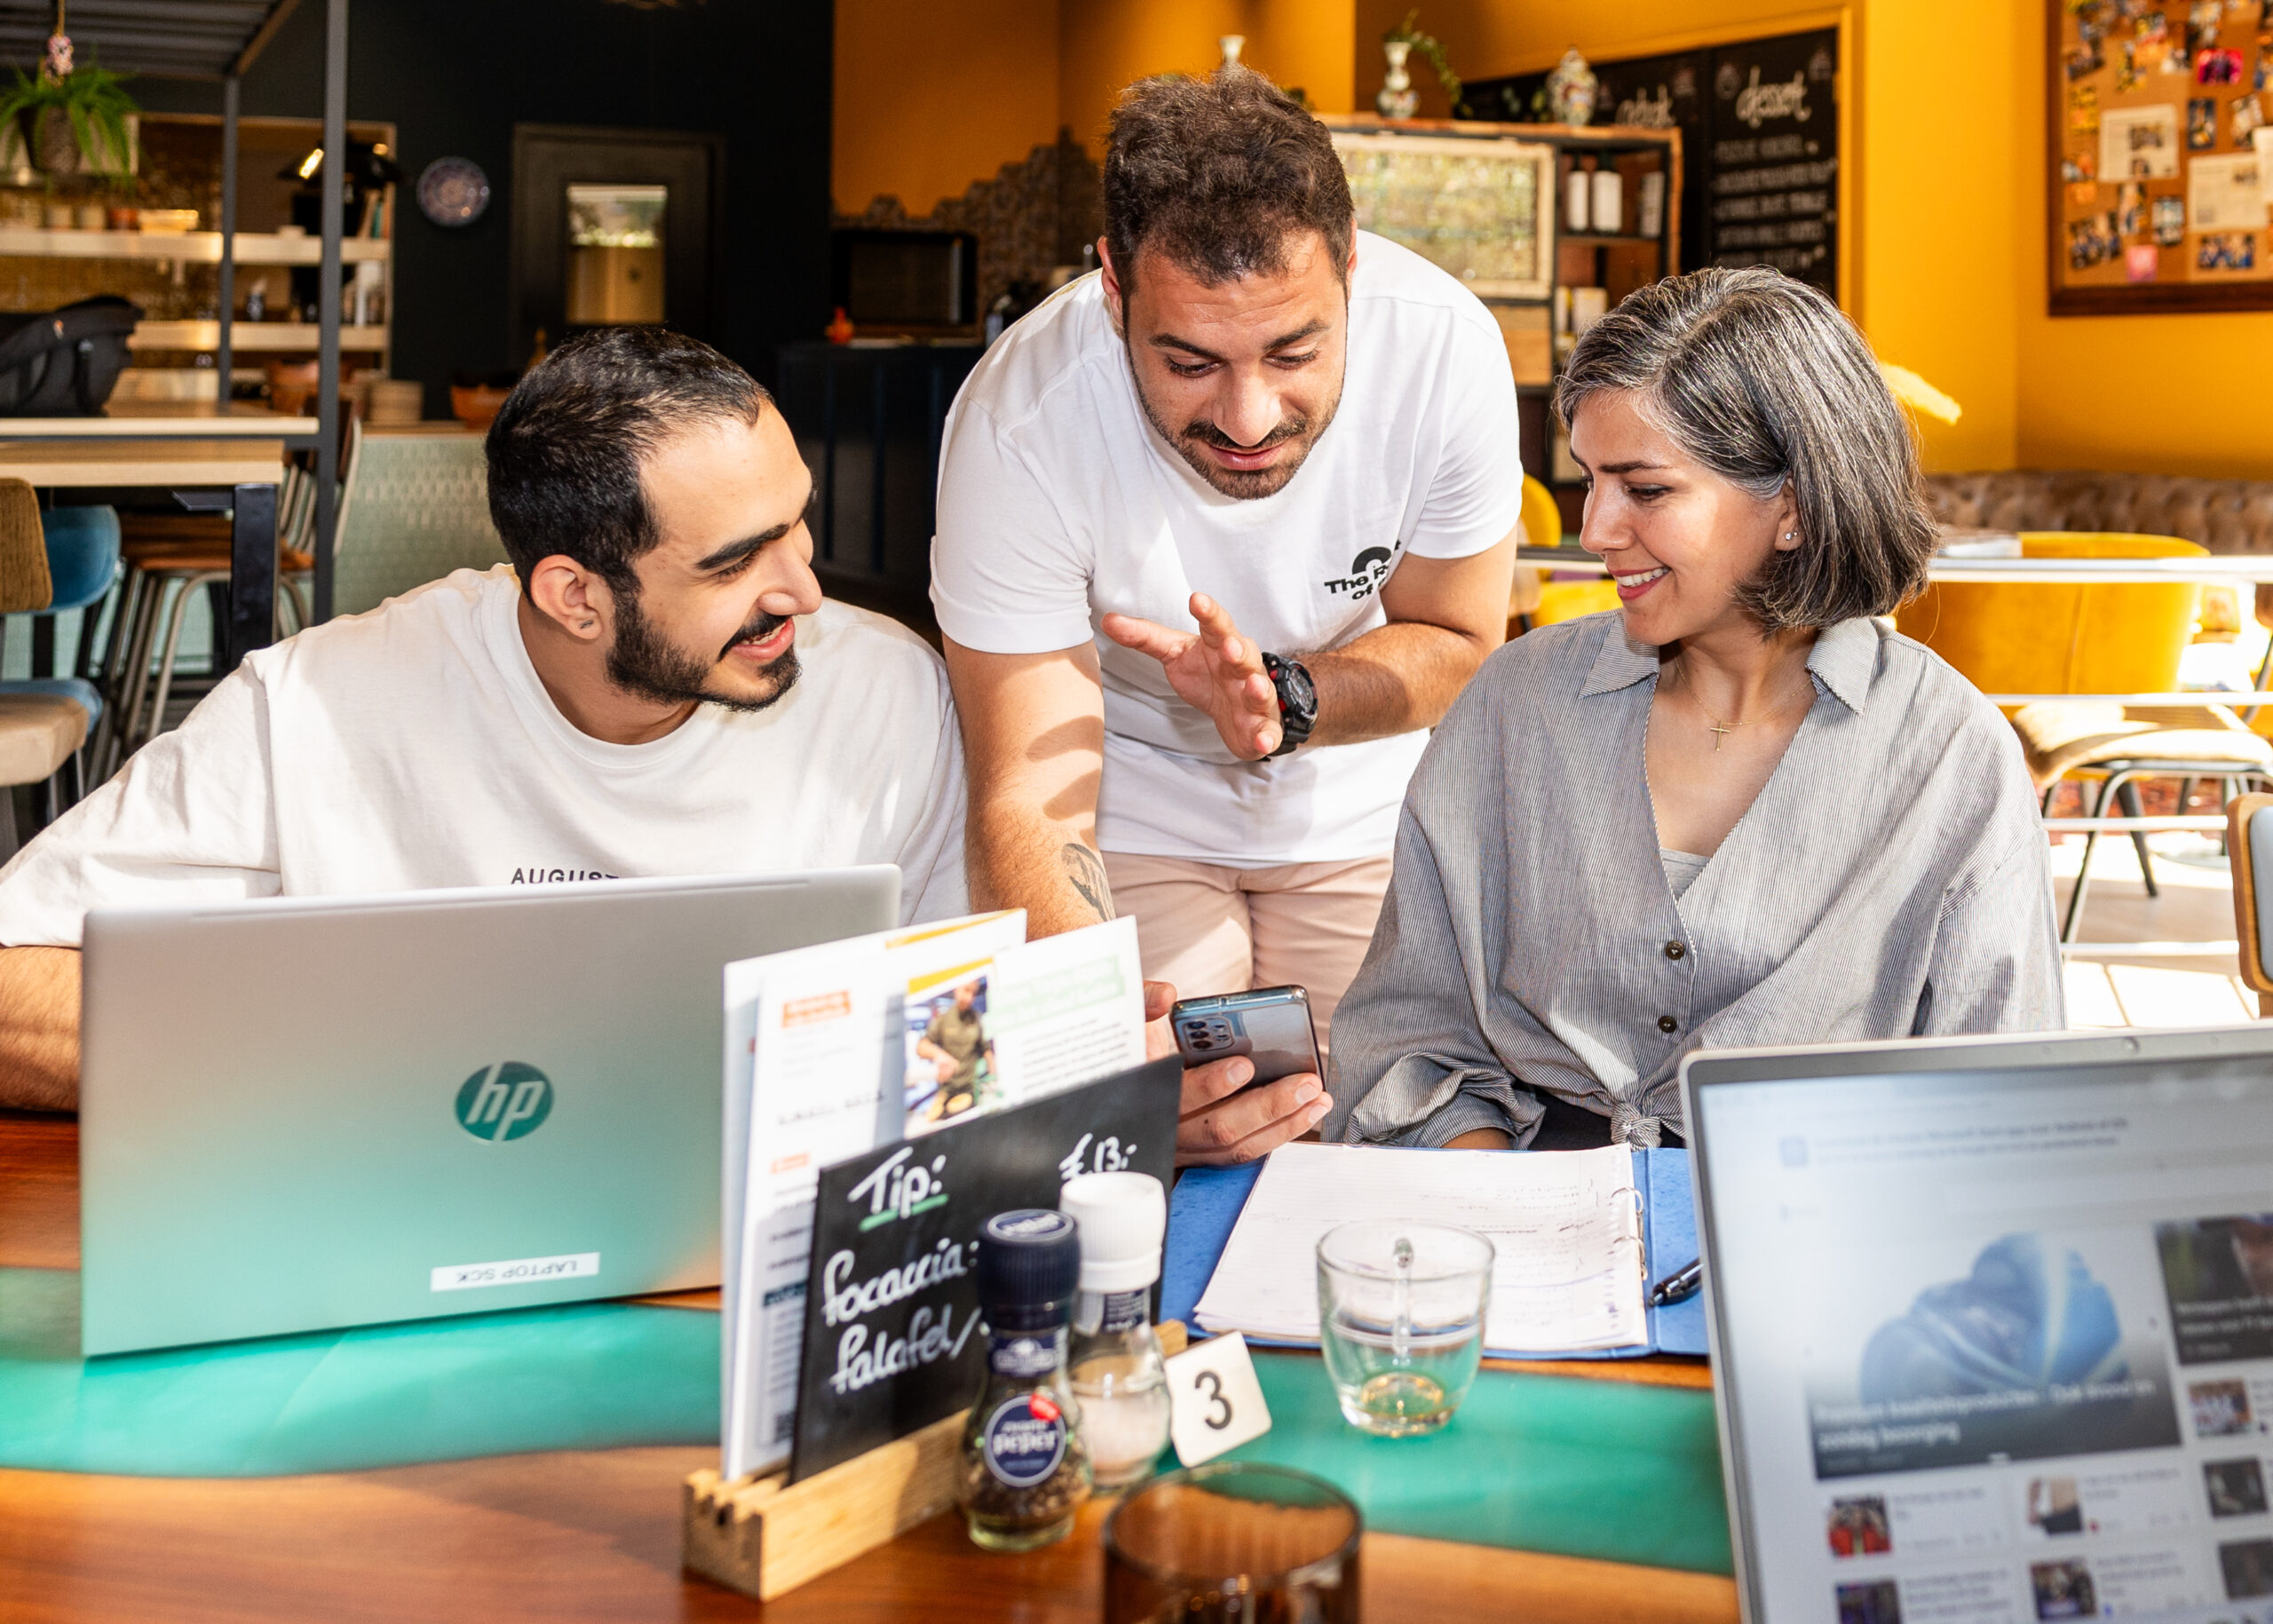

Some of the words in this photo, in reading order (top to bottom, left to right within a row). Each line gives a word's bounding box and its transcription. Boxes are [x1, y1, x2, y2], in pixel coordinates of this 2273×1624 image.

[1324, 575, 1369, 594] The
[1351, 582, 1374, 600] of
[463, 1062, 547, 1142] hp
[847, 1145, 947, 1219] Tip:
[457, 1267, 496, 1283] SCK
[503, 1259, 578, 1279] LAPTOP
[1194, 1370, 1232, 1430] 3
